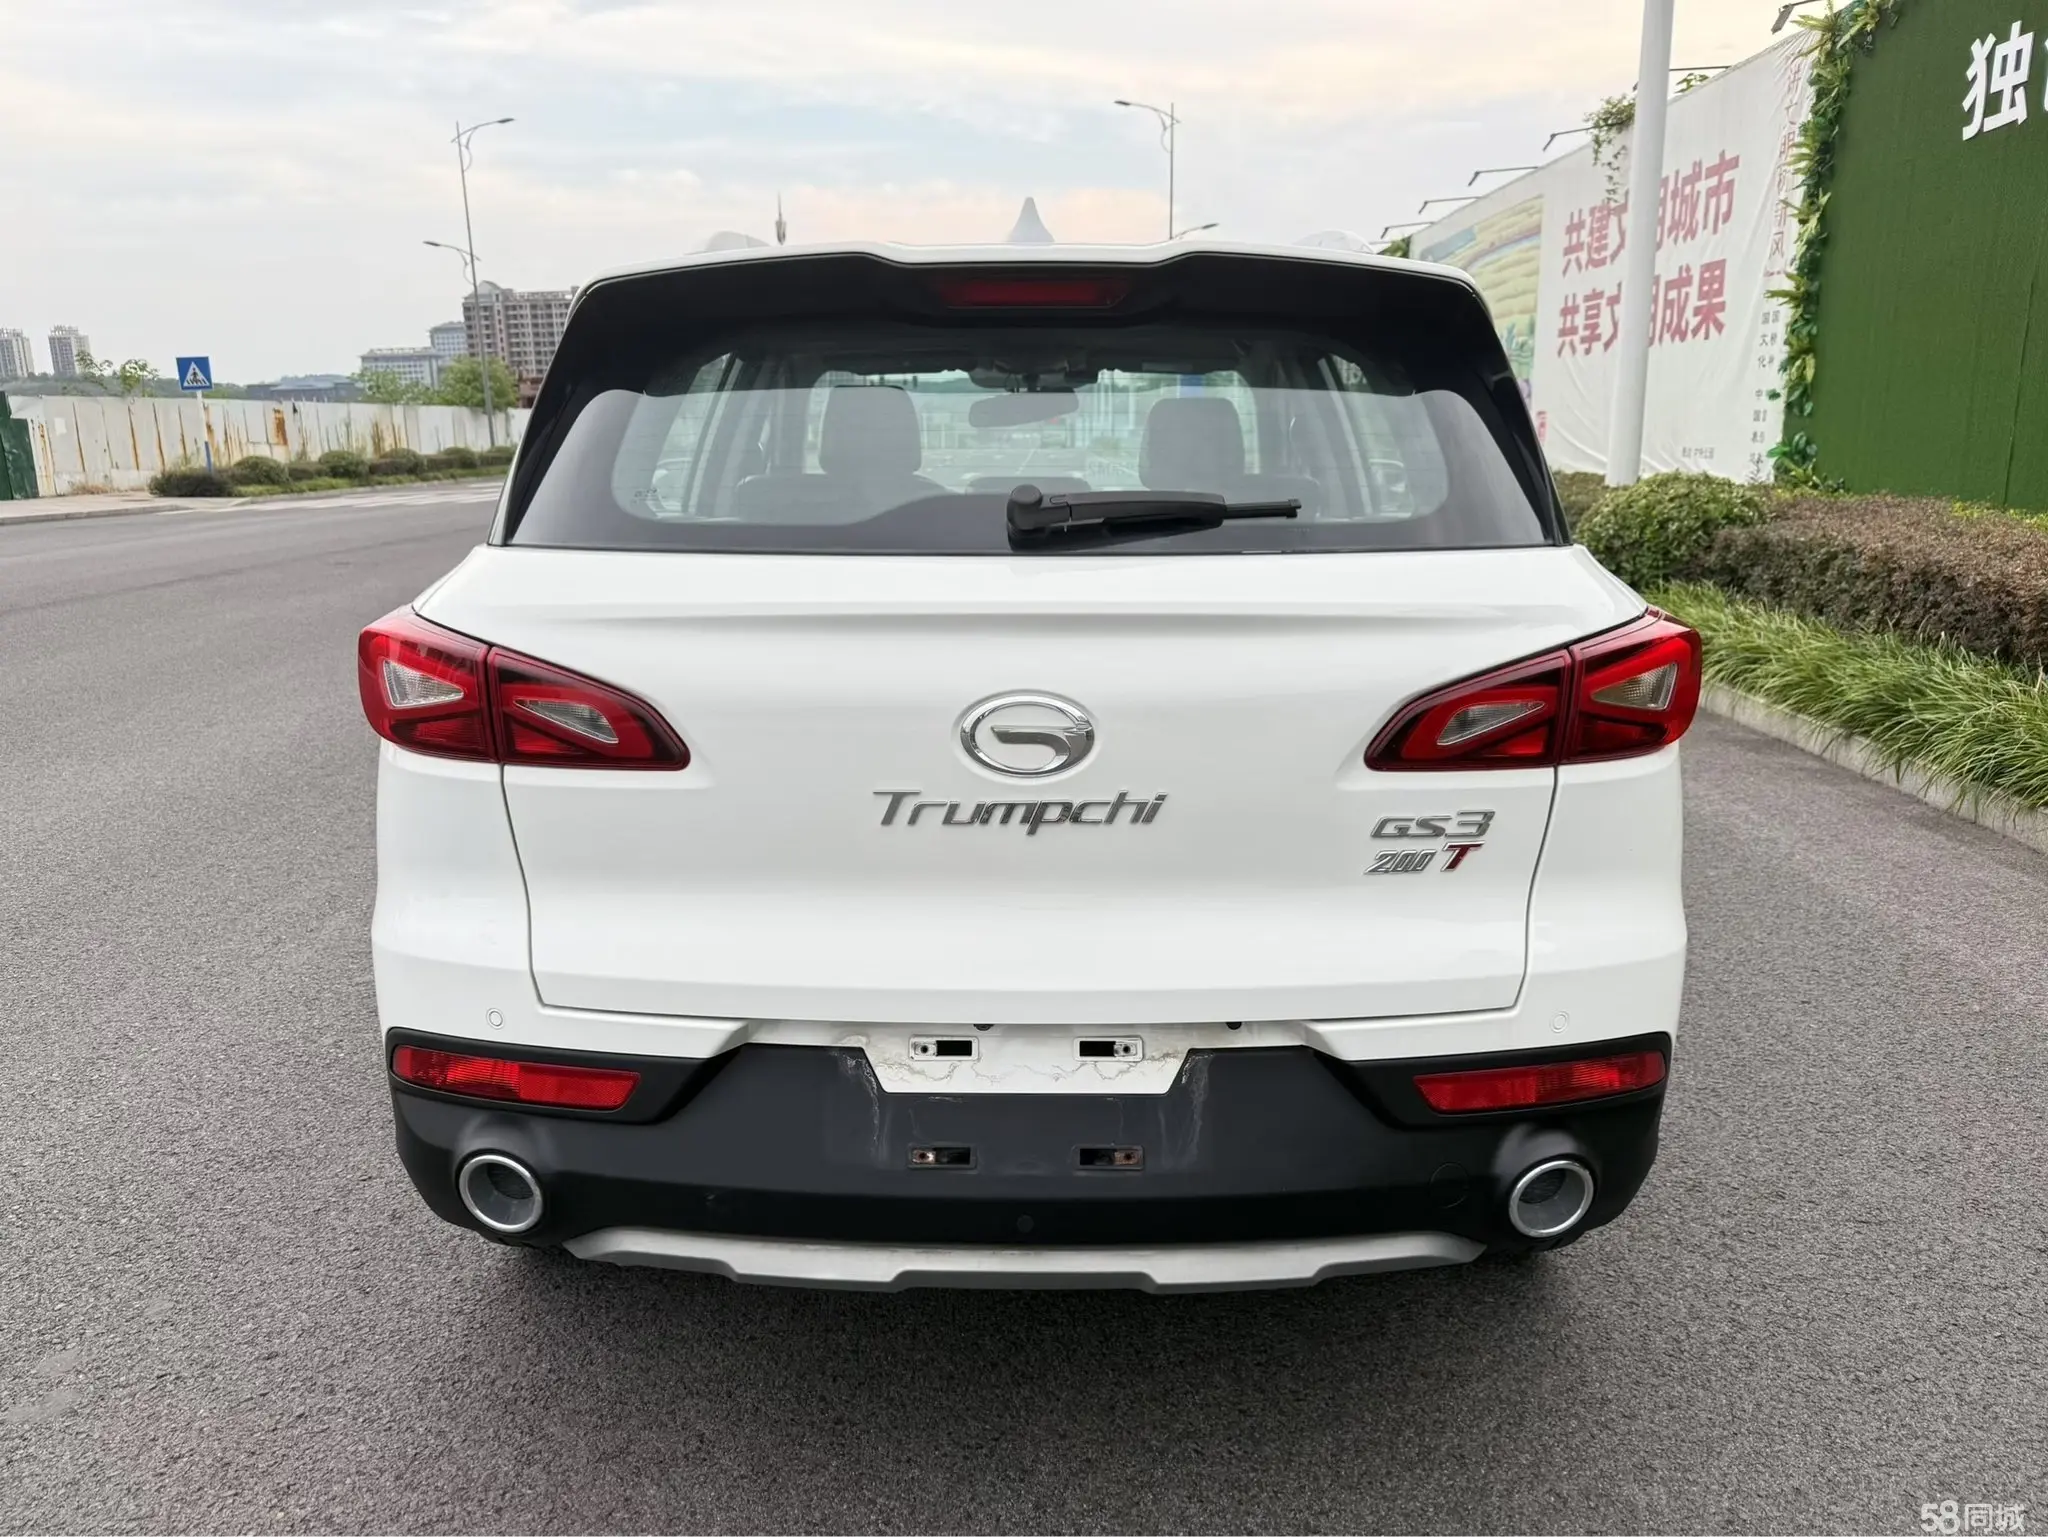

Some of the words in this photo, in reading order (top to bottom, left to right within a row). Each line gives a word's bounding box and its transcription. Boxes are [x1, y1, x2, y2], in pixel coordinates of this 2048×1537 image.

[1961, 19, 2048, 141] 独
[872, 789, 1168, 836] Trumpchi
[1370, 808, 1496, 839] GS3
